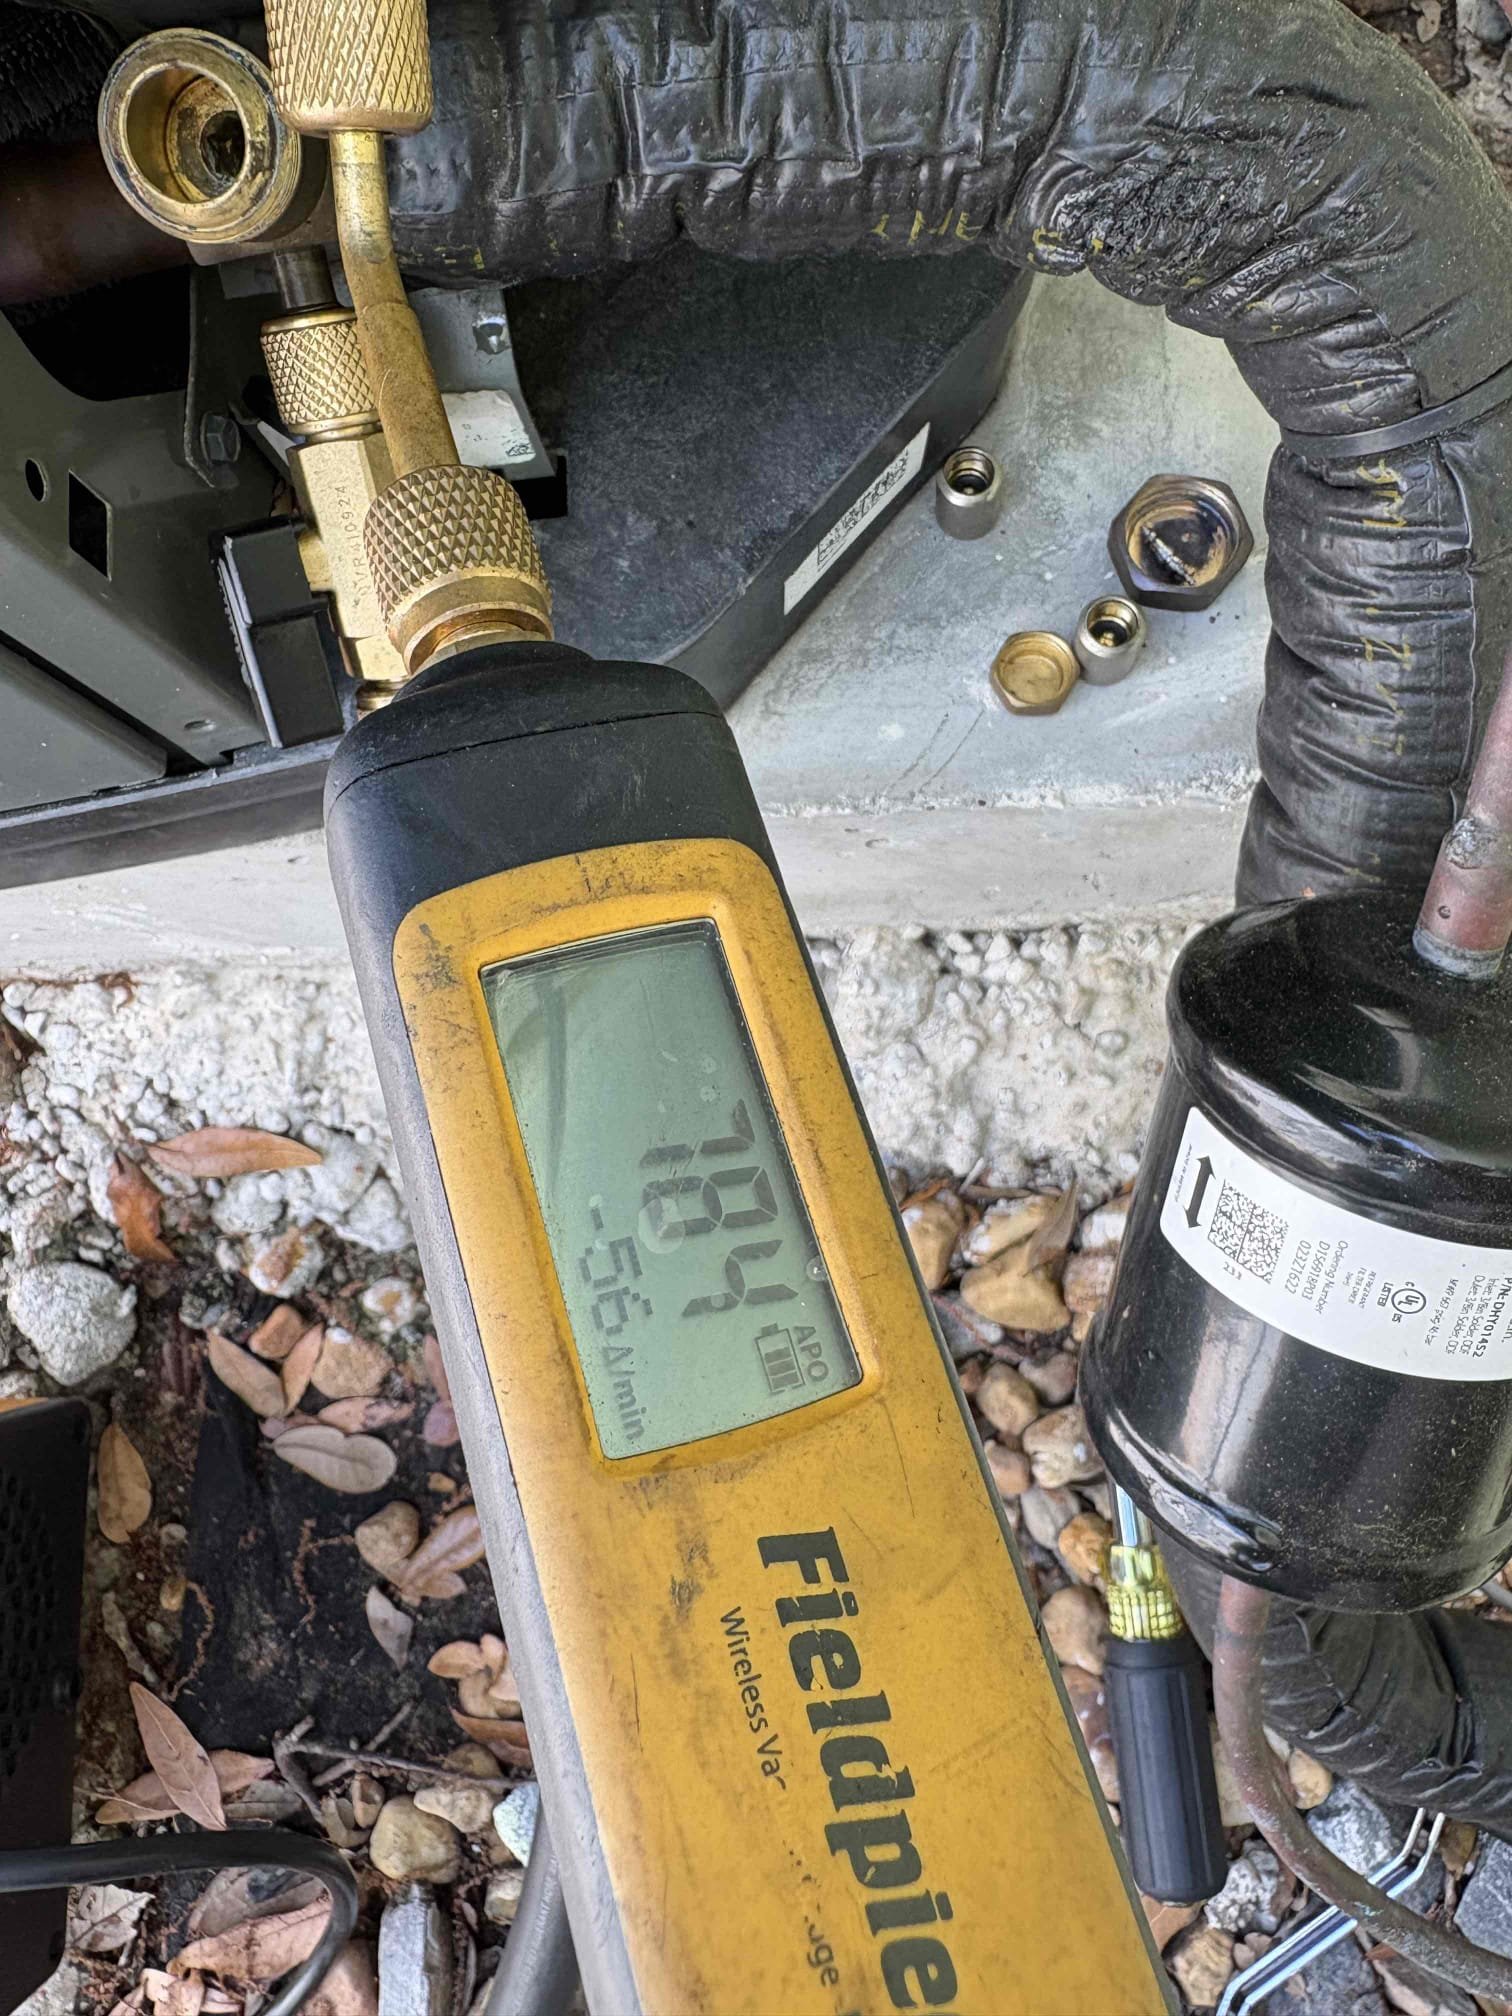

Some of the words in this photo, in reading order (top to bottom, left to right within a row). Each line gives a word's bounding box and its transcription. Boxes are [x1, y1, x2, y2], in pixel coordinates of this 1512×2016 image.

[578, 1206, 654, 1337] -56
[639, 1098, 799, 1318] 784
[1325, 1240, 1349, 1279] Ordering
[793, 1324, 830, 1382] APO
[1315, 1280, 1335, 1314] Number
[720, 1605, 769, 1734] Wireless
[756, 1526, 959, 2016] Fieldpie
